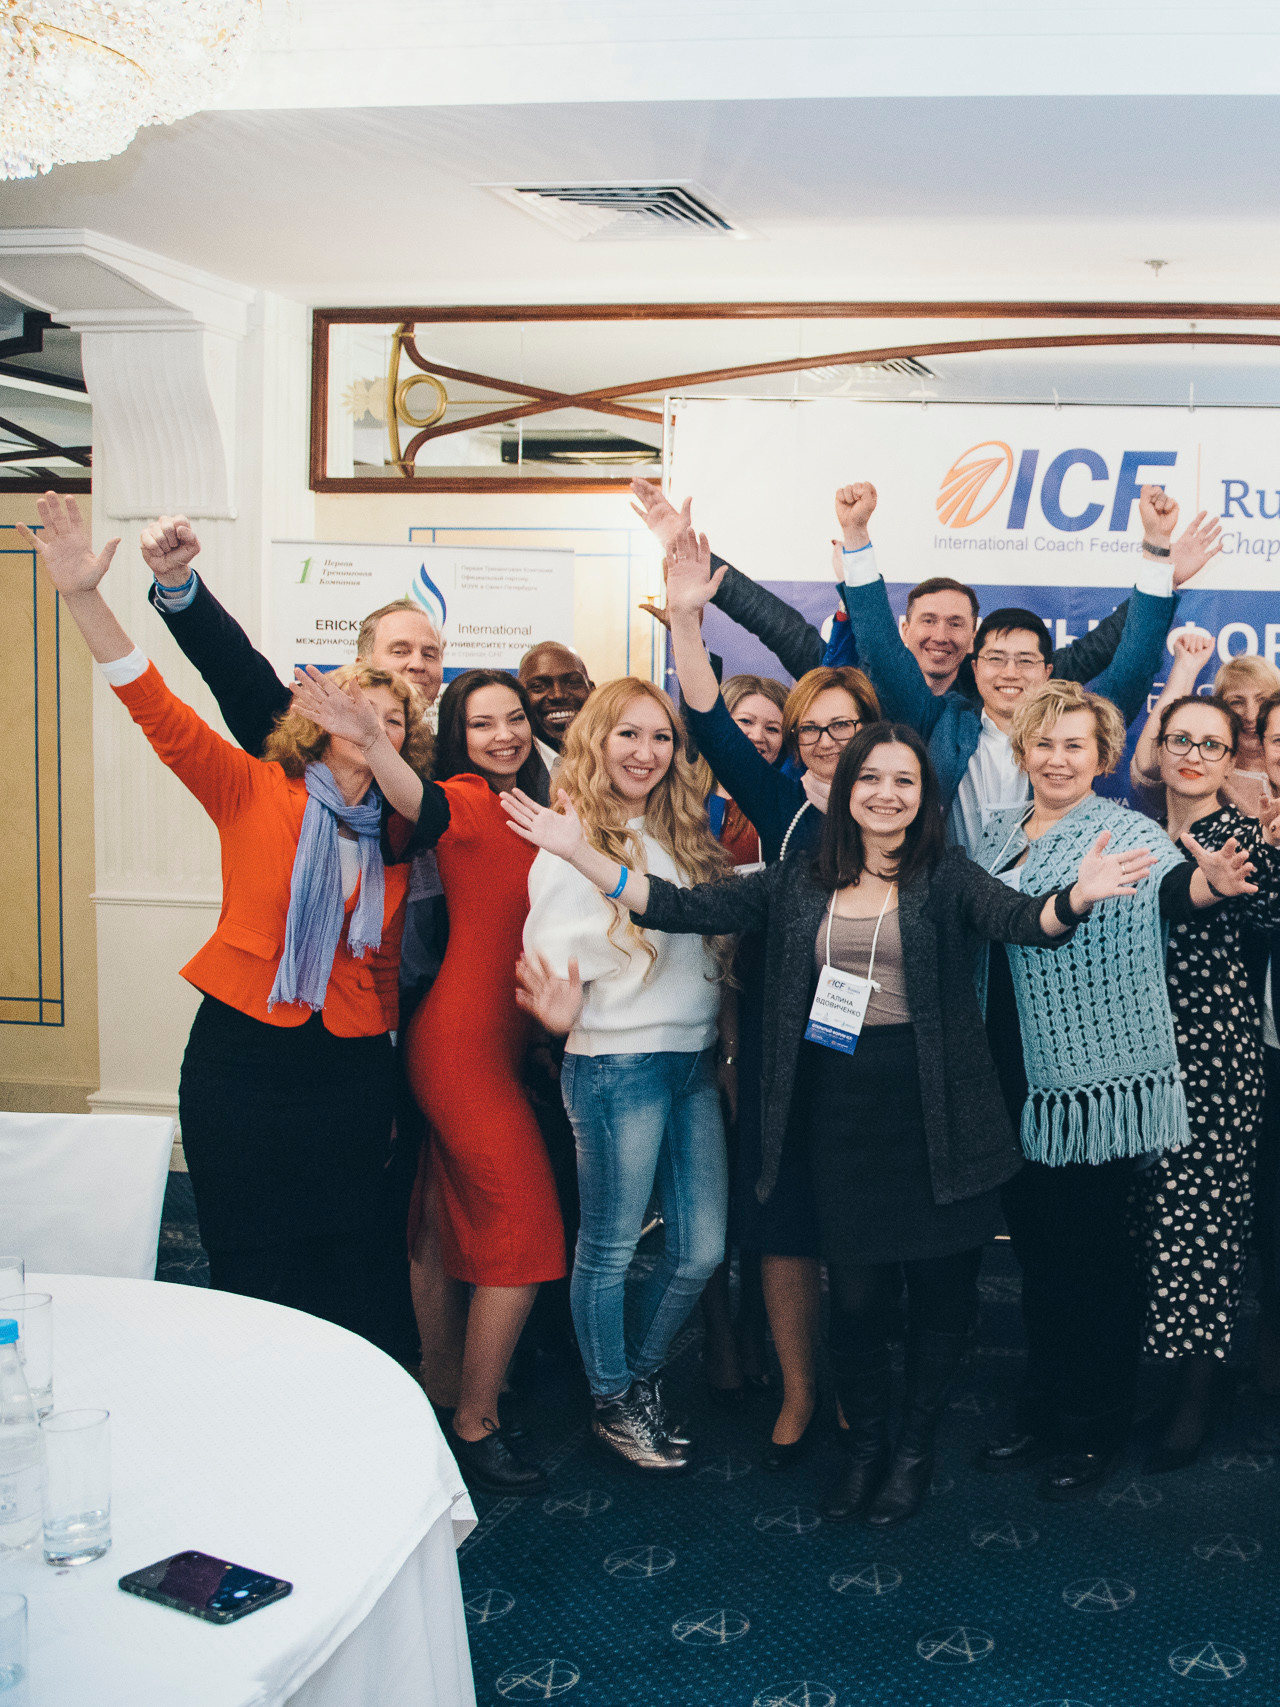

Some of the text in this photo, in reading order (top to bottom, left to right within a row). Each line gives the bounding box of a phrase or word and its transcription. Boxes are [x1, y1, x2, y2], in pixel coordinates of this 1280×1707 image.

[1006, 447, 1178, 532] ICF
[933, 536, 1145, 554] International Coach Federa
[324, 559, 353, 568] Первая
[319, 578, 361, 586] Компания
[458, 623, 532, 636] International
[295, 638, 359, 646] МЕЖДУНАРОД
[449, 641, 506, 649] УНИВЕРСИТЕТ
[831, 980, 845, 989] ICF
[827, 992, 854, 1006] ГАЛИНА
[815, 996, 861, 1018] ВДОВИЧЕНКО
